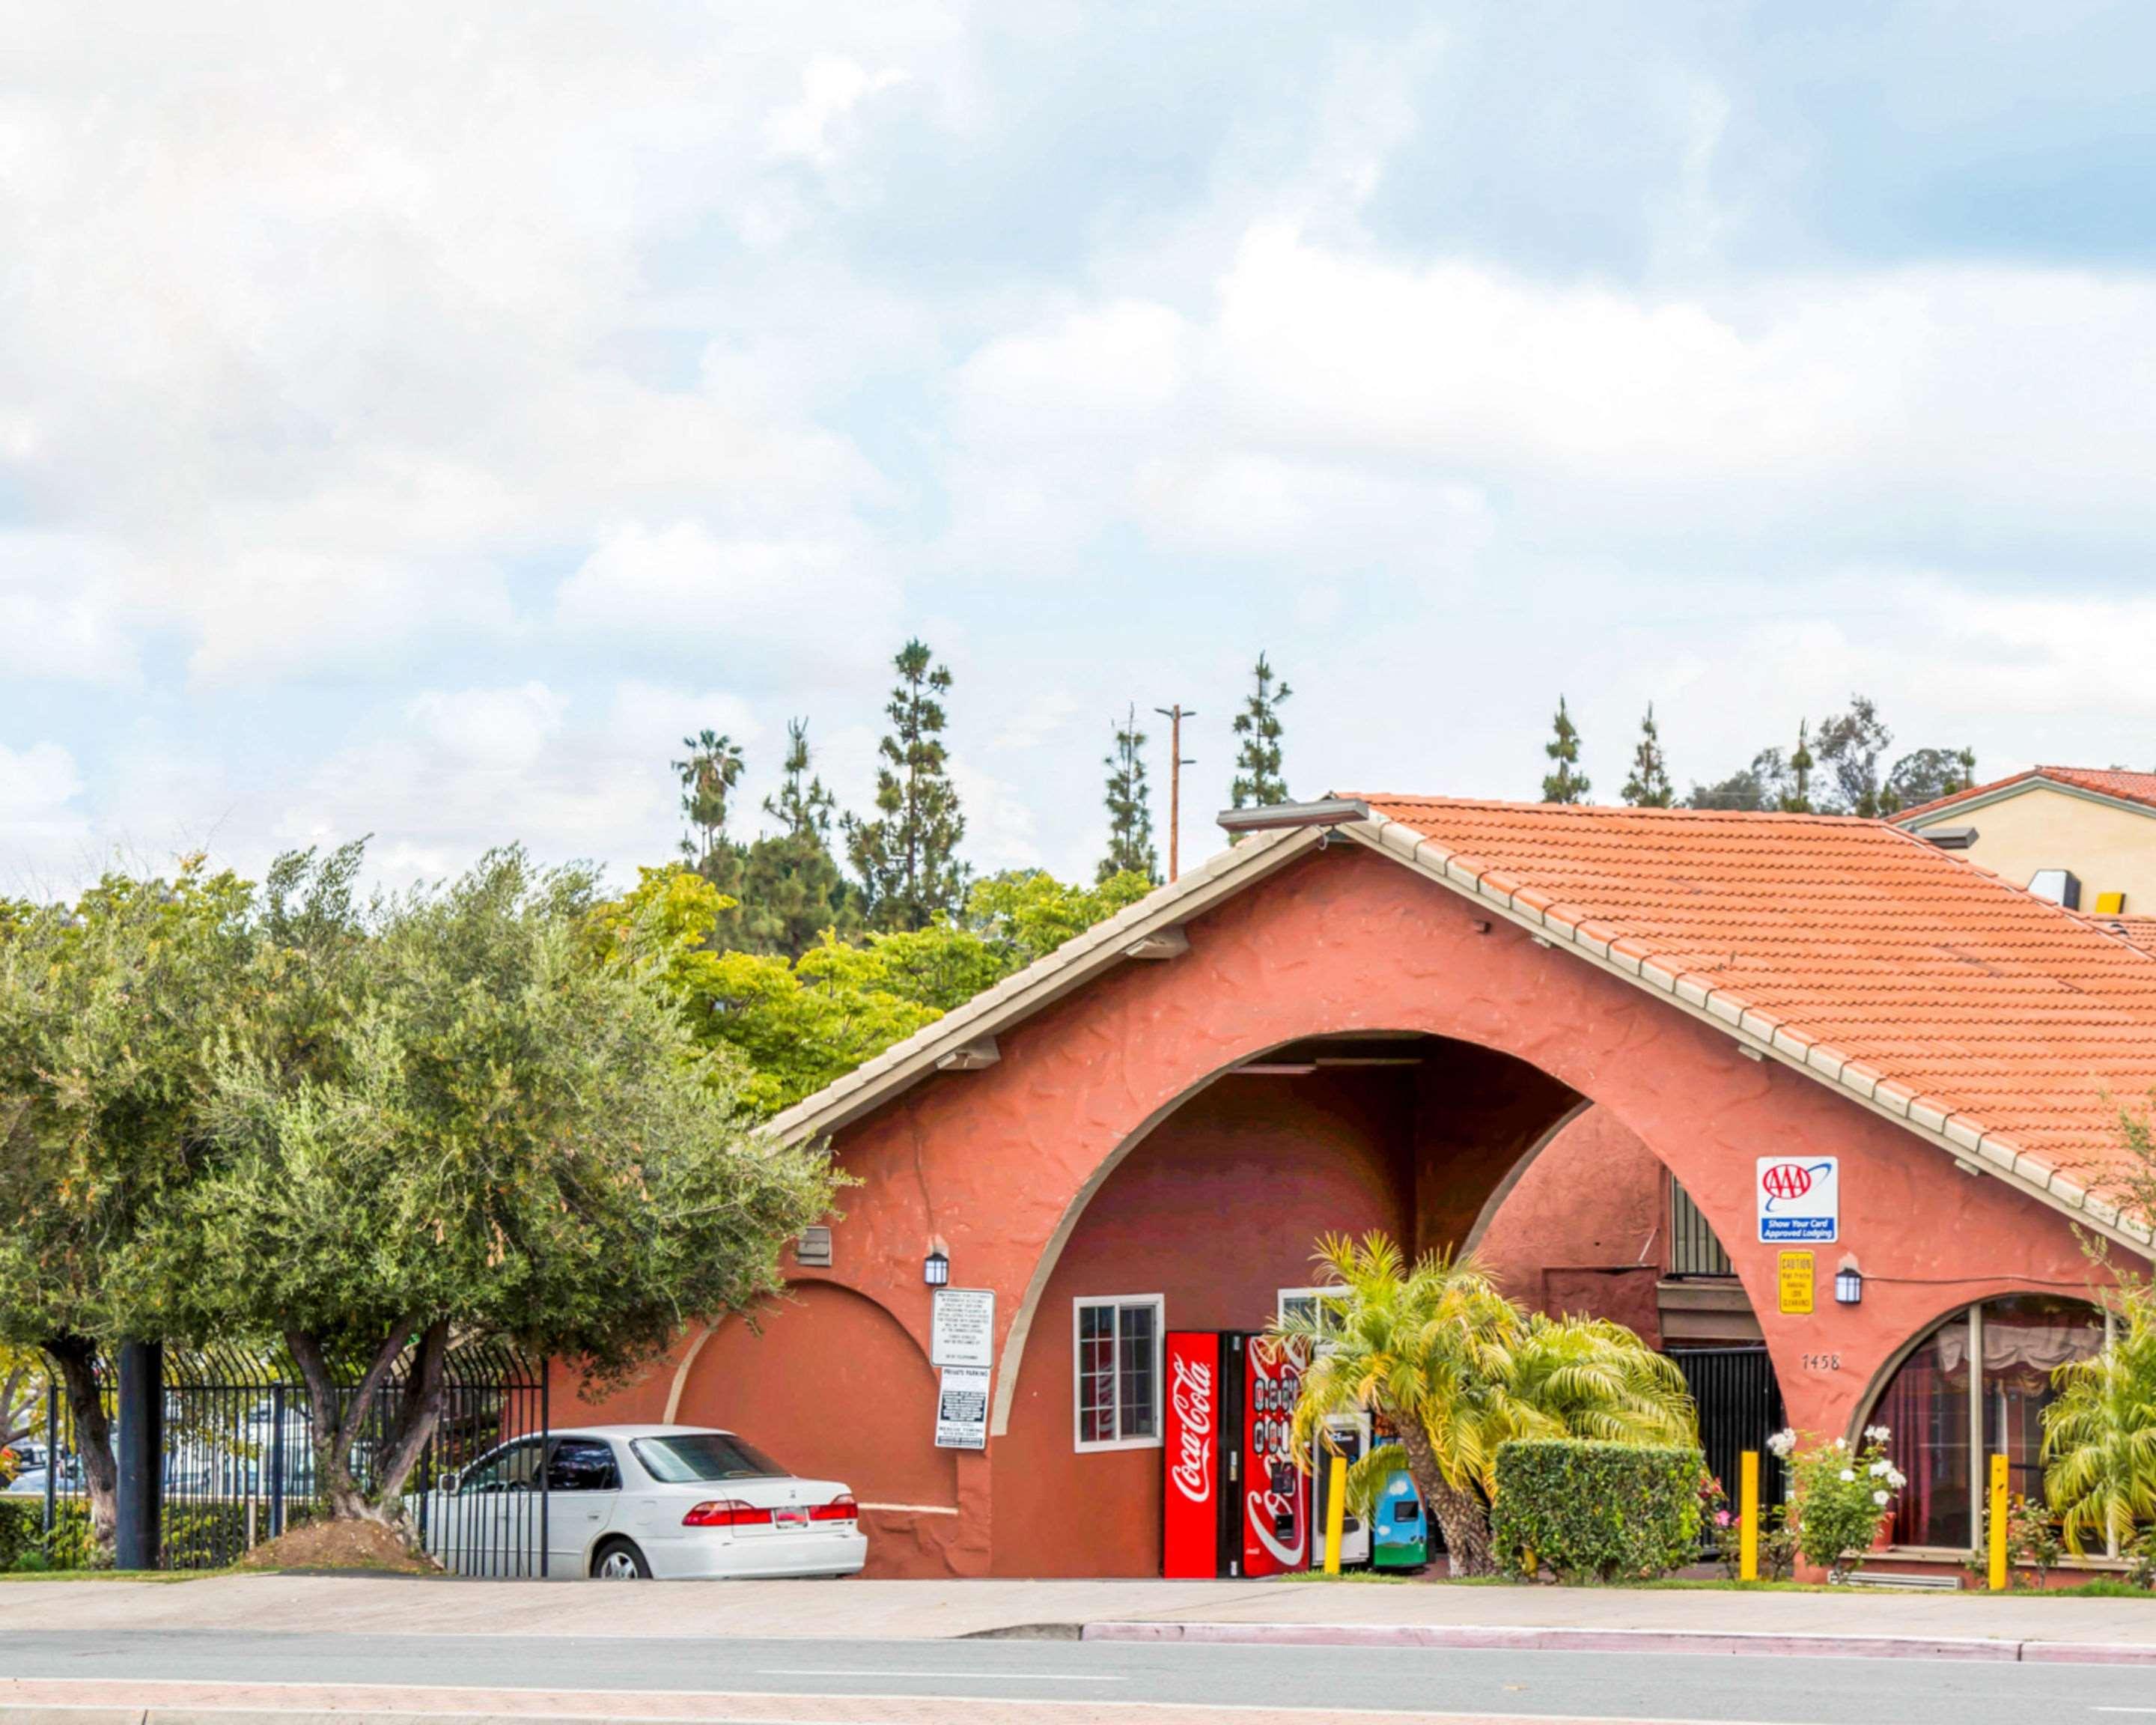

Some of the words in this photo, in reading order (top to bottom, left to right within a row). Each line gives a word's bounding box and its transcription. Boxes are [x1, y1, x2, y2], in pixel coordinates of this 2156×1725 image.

[1765, 1163, 1809, 1199] AAA
[1767, 1220, 1791, 1229] Show
[1791, 1220, 1809, 1229] Your
[1810, 1220, 1829, 1229] Card
[1764, 1229, 1802, 1239] Approved
[1803, 1229, 1833, 1239] Lodging
[1782, 1259, 1812, 1270] CAUTION
[1172, 1352, 1211, 1503] Coca-Cola
